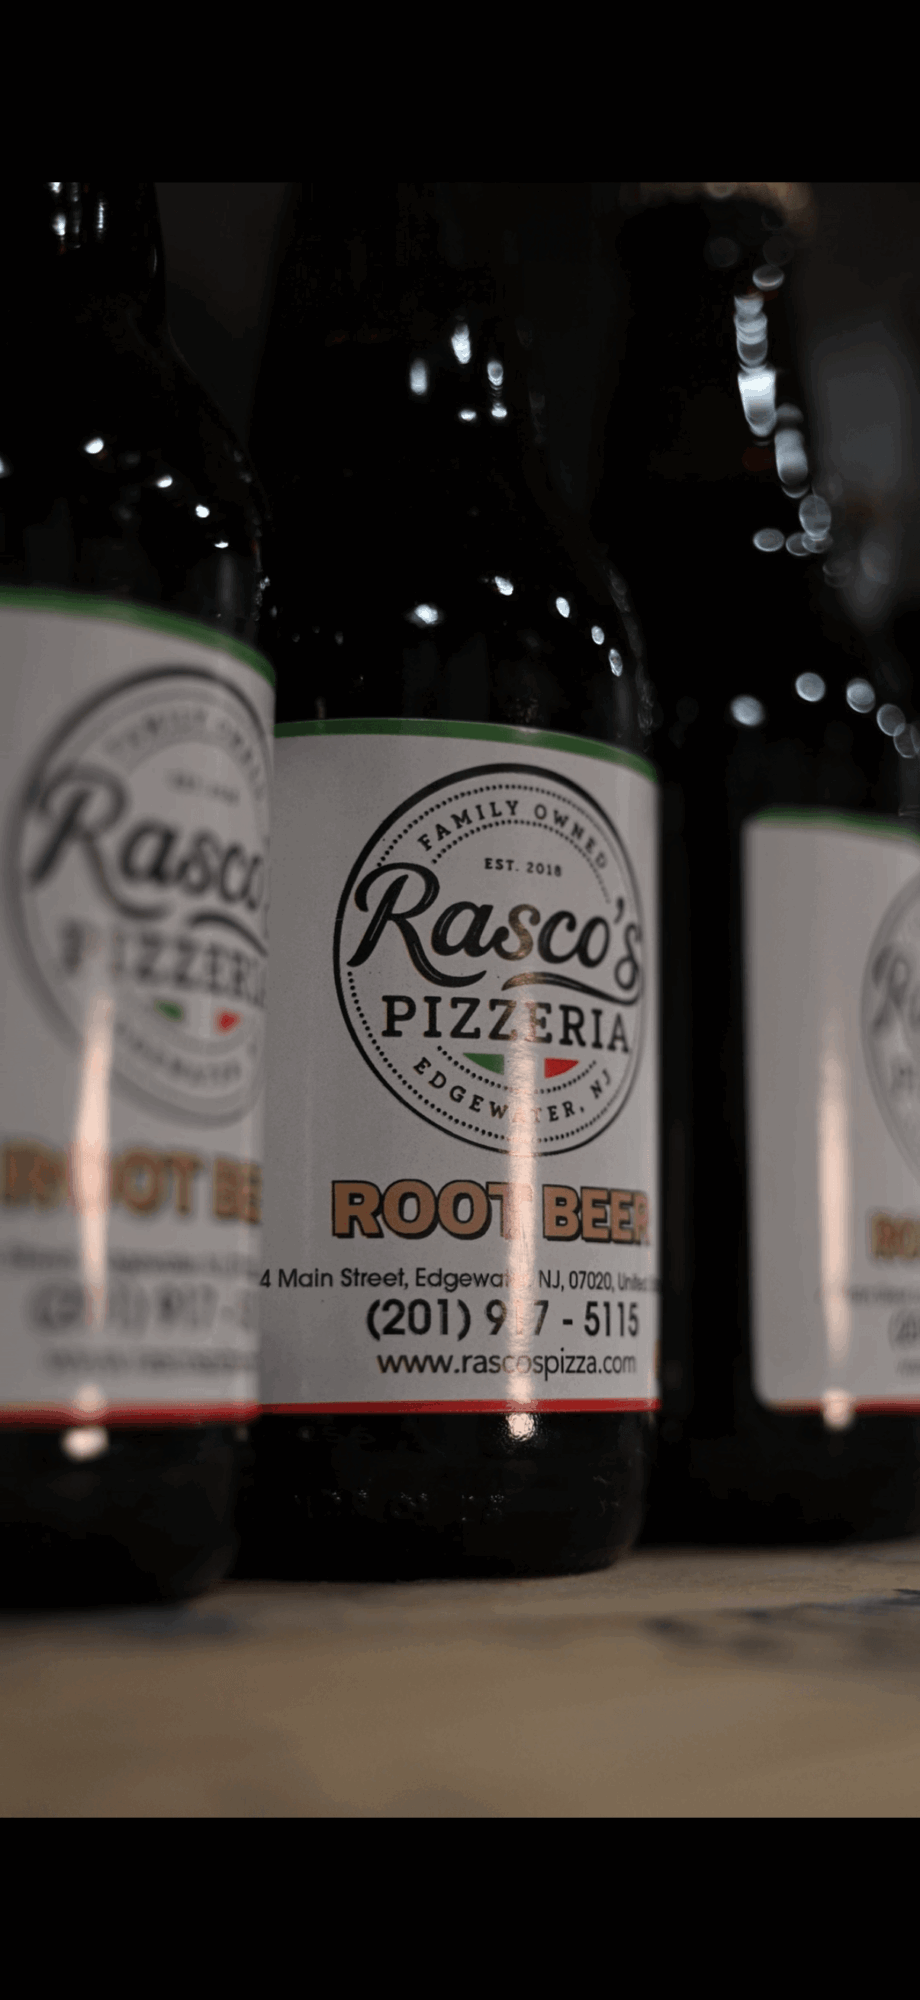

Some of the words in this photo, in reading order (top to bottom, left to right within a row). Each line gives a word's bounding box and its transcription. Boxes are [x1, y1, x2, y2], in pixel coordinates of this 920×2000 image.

[417, 799, 521, 853] FAMILY
[533, 803, 609, 871] OWNED
[483, 857, 520, 873] EST.
[526, 860, 563, 878] 2018
[346, 861, 643, 1005] Rasco's
[380, 994, 630, 1054] PIZZERIA
[331, 1178, 534, 1241] ROOT
[541, 1183, 651, 1246] BEER
[277, 1267, 334, 1289] Main
[340, 1267, 410, 1291] Street,
[538, 1269, 565, 1293] NJ,
[568, 1271, 616, 1293] 07020,
[366, 1298, 472, 1341] (201)
[583, 1300, 640, 1338] 5115
[376, 1347, 638, 1382] www.rascospizza.com
